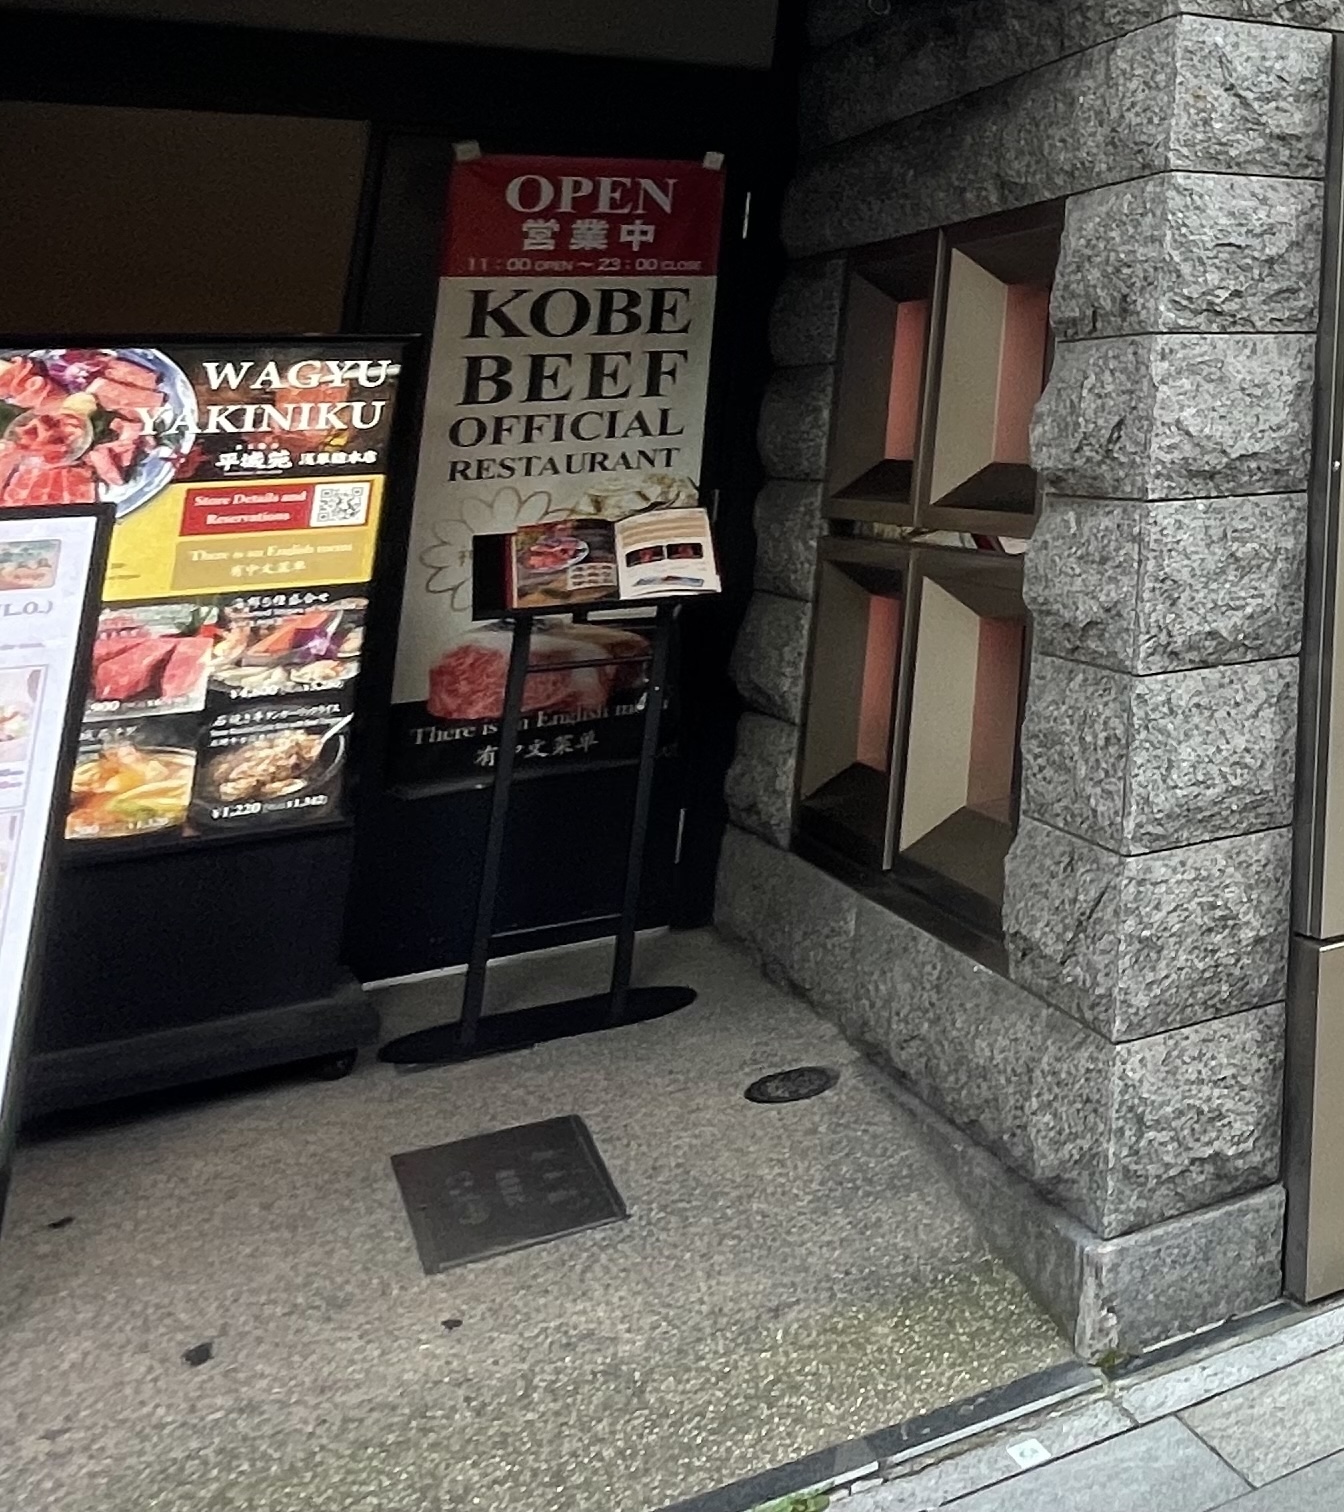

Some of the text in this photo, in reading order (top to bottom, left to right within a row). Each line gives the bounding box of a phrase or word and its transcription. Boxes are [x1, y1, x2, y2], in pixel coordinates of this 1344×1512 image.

[505, 174, 679, 215] OPEN
[522, 218, 656, 252] 営業中
[461, 287, 693, 341] KOBE
[202, 358, 393, 392] WAGYU
[455, 348, 690, 408] BEEF
[136, 399, 387, 437] YAKINIKU
[448, 406, 686, 449] OFFICIAL
[447, 445, 683, 484] RESTAURANT
[411, 723, 477, 745] There
